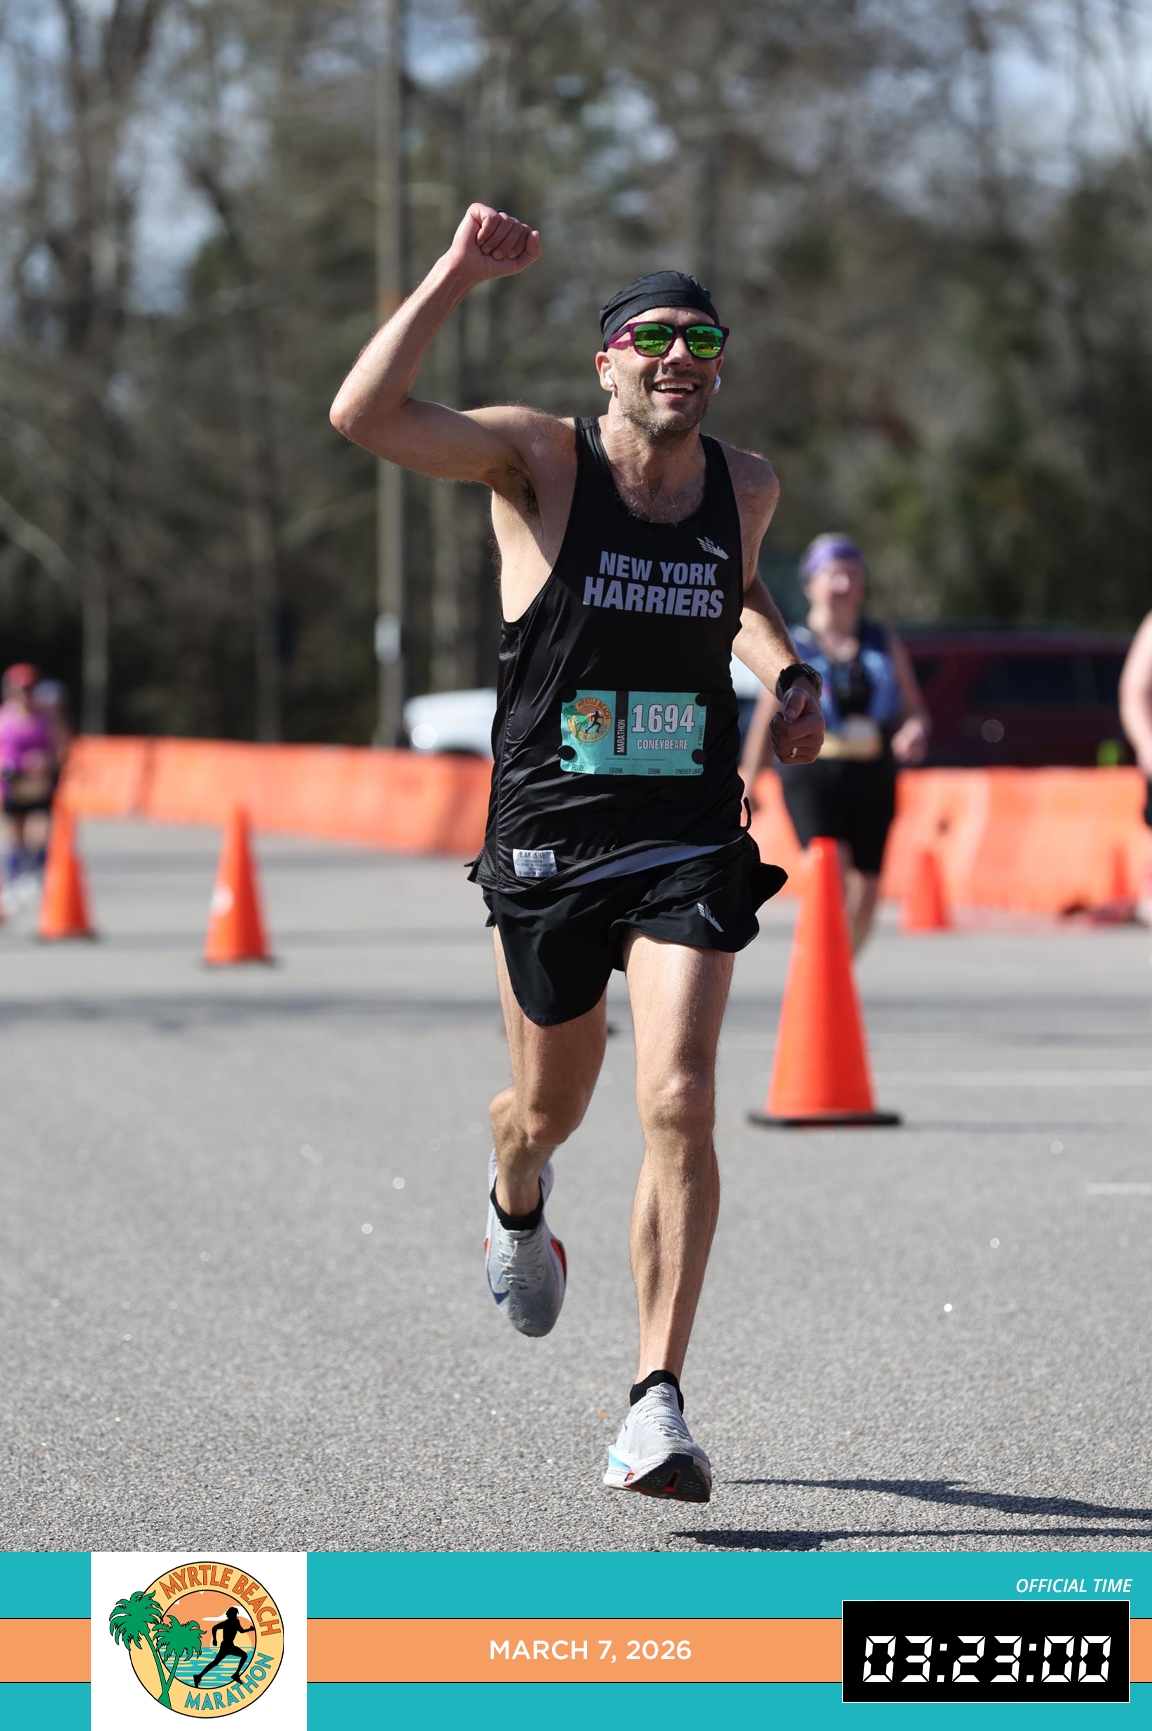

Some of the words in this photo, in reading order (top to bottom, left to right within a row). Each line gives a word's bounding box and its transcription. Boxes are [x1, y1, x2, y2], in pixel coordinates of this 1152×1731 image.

[599, 550, 653, 582] NEW
[659, 561, 718, 586] YORK
[582, 576, 725, 619] HARRIERS
[631, 704, 695, 734] 1694
[616, 719, 626, 753] MARATHON
[637, 739, 688, 750] CONEYBEARE
[647, 767, 661, 775] DRINK
